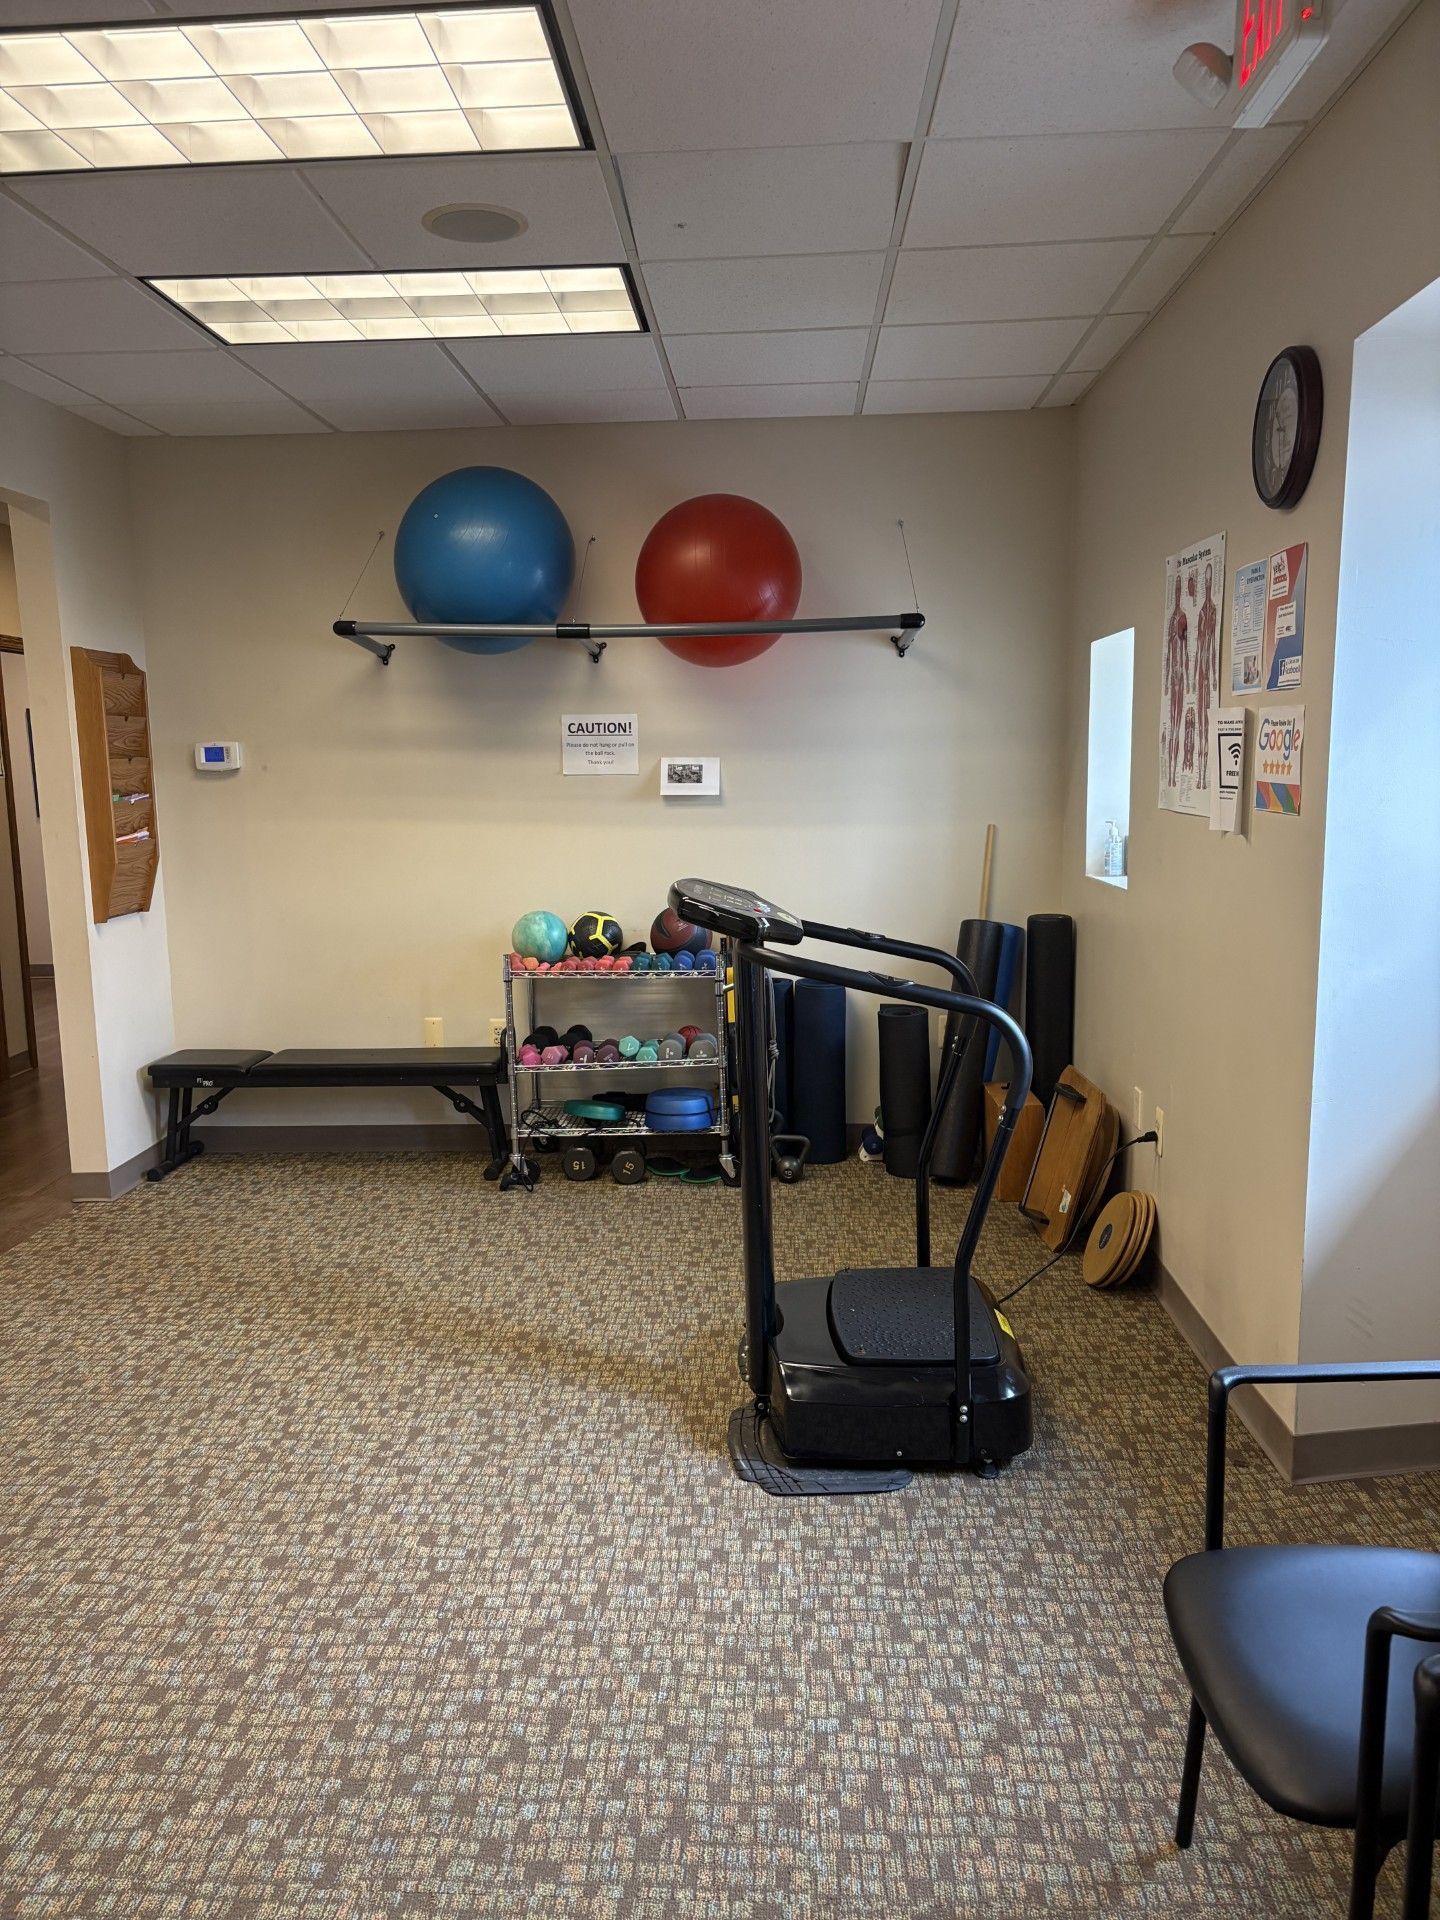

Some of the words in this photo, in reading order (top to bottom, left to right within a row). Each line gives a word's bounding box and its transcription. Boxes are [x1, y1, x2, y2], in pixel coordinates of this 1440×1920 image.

[567, 721, 632, 734] CAUTION!
[1259, 717, 1301, 761] Google
[572, 1160, 586, 1171] 15
[622, 1161, 636, 1175] 15
